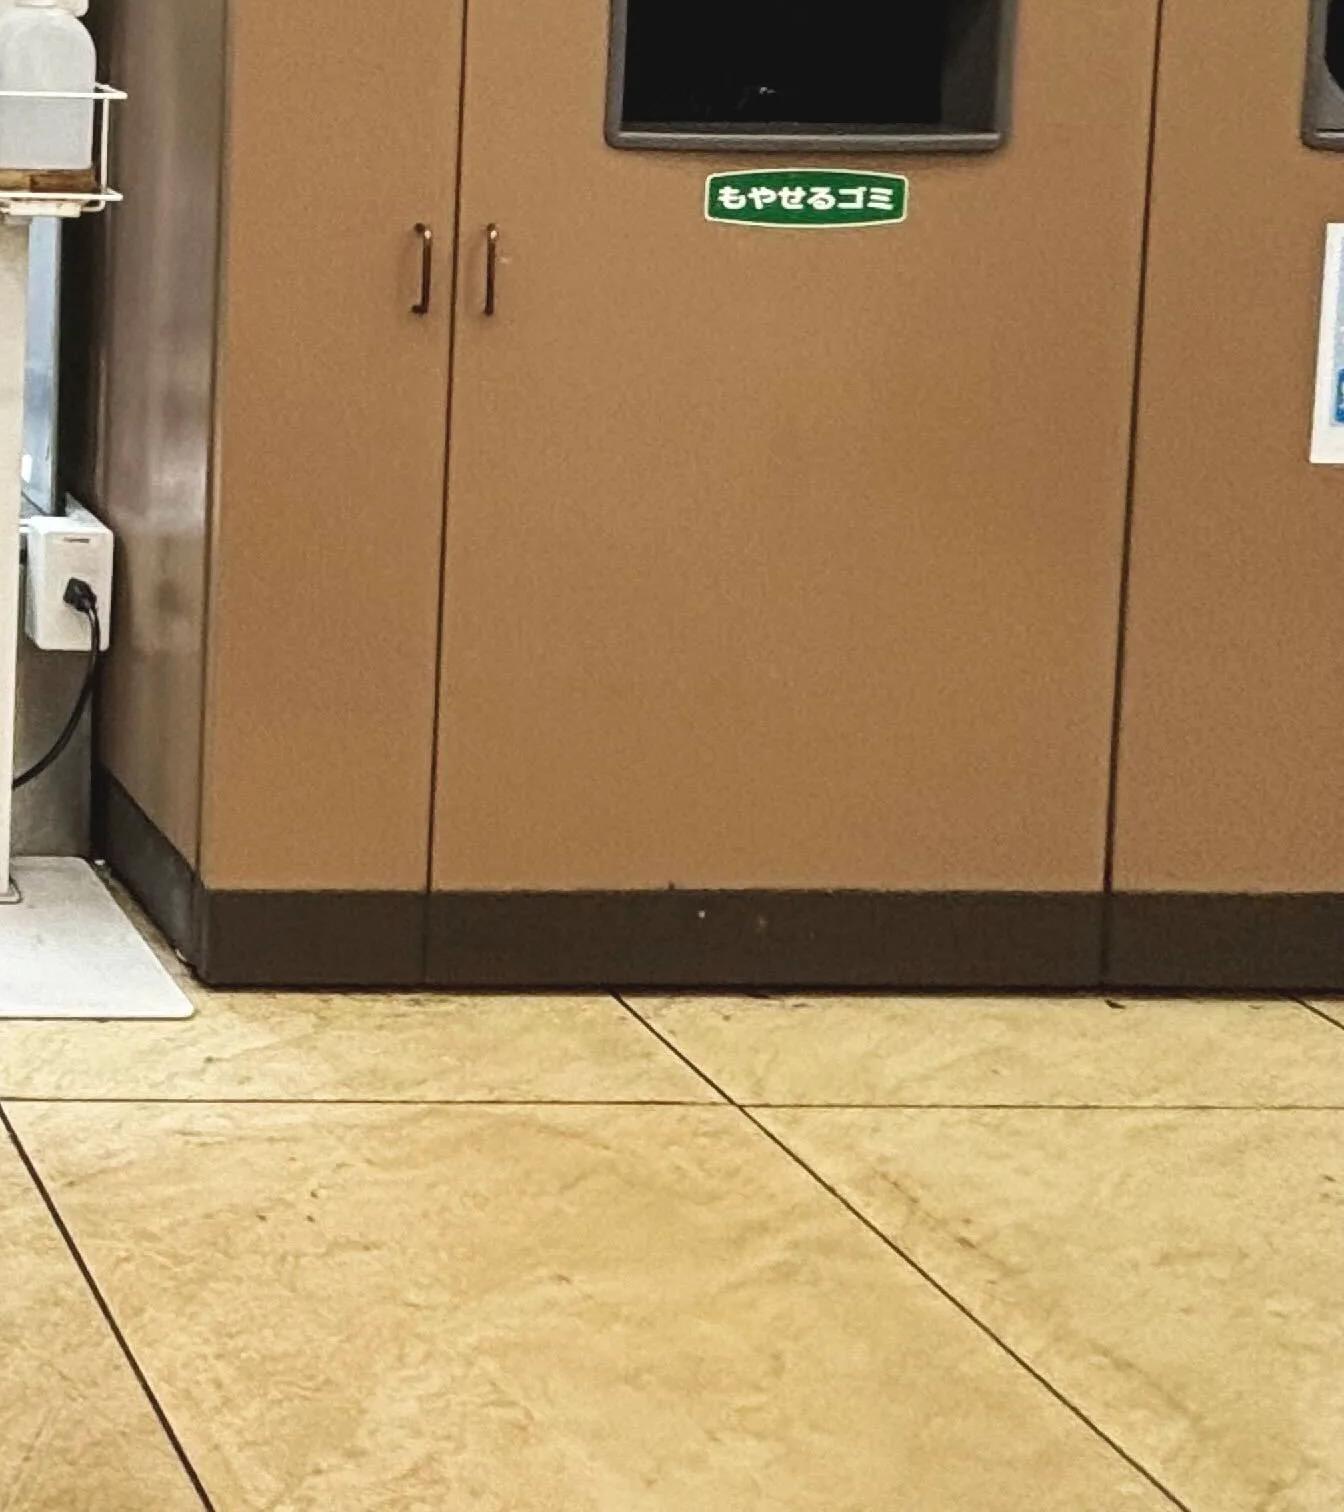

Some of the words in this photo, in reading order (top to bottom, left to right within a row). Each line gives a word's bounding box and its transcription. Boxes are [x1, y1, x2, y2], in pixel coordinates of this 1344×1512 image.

[717, 184, 896, 213] もやせるゴミ
